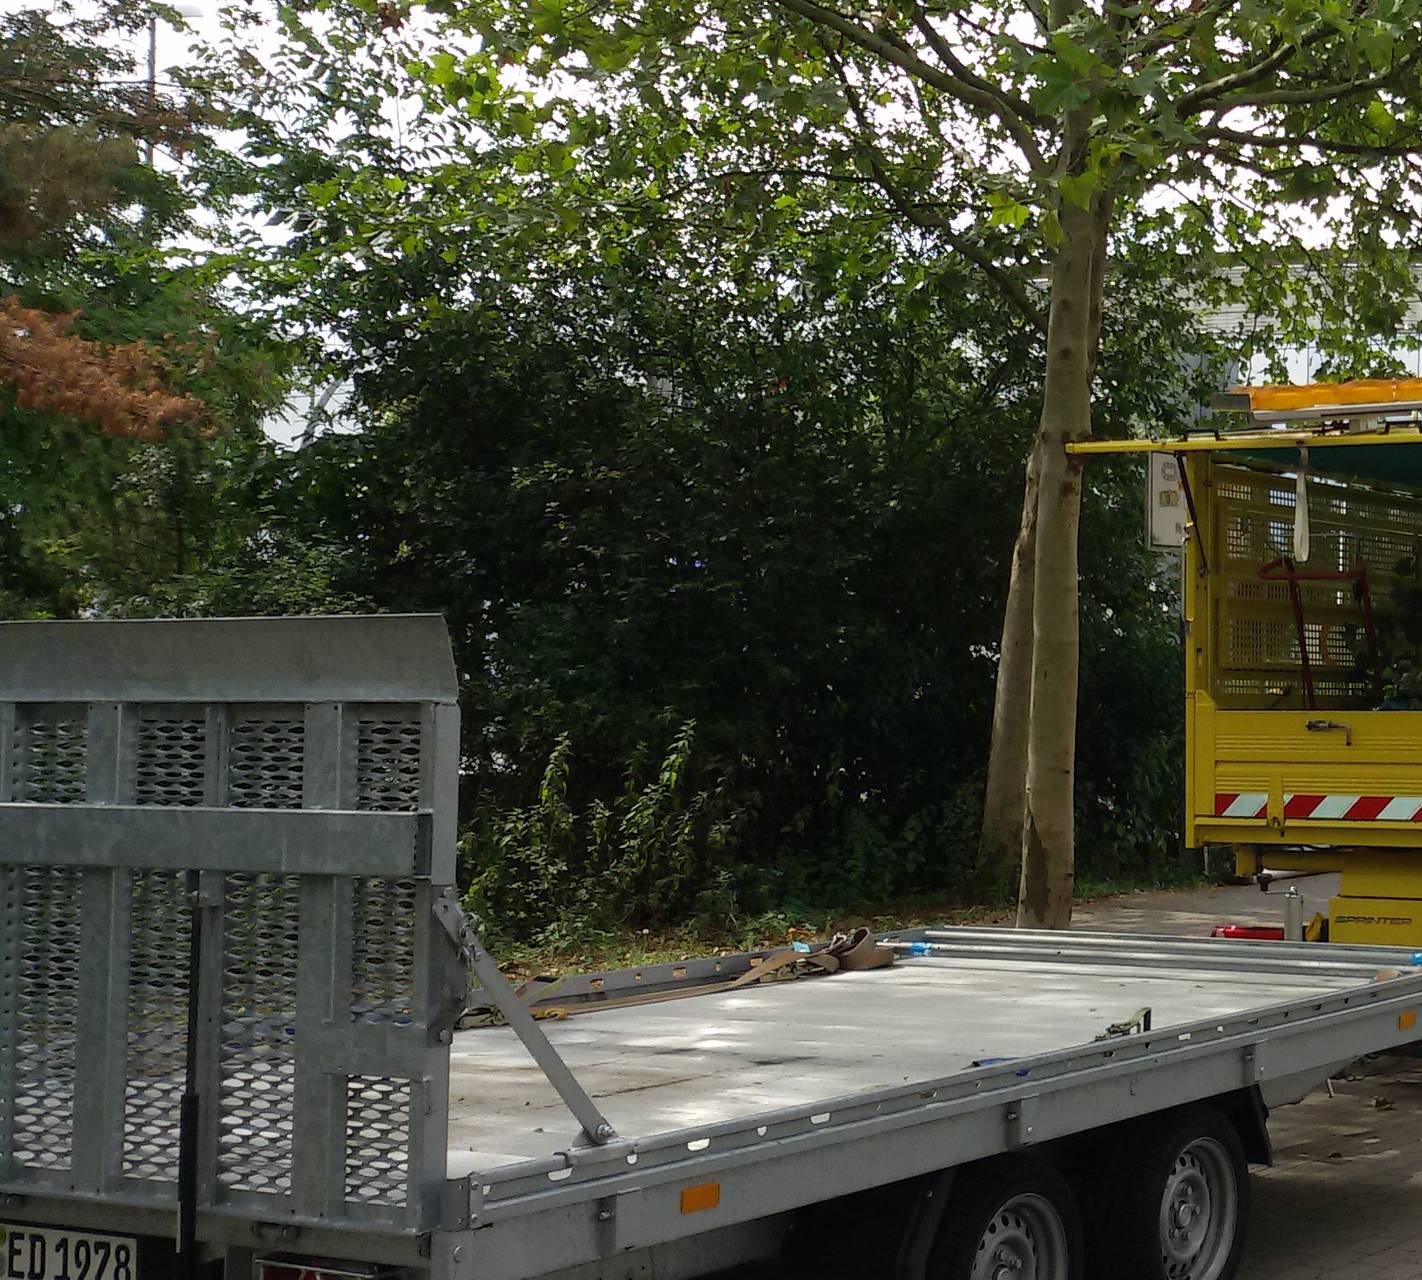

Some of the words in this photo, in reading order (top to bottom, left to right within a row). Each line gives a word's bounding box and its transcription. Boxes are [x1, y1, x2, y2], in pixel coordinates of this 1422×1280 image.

[1335, 915, 1413, 926] SPRINTER
[8, 1231, 46, 1280] ED
[54, 1237, 132, 1280] 1978
